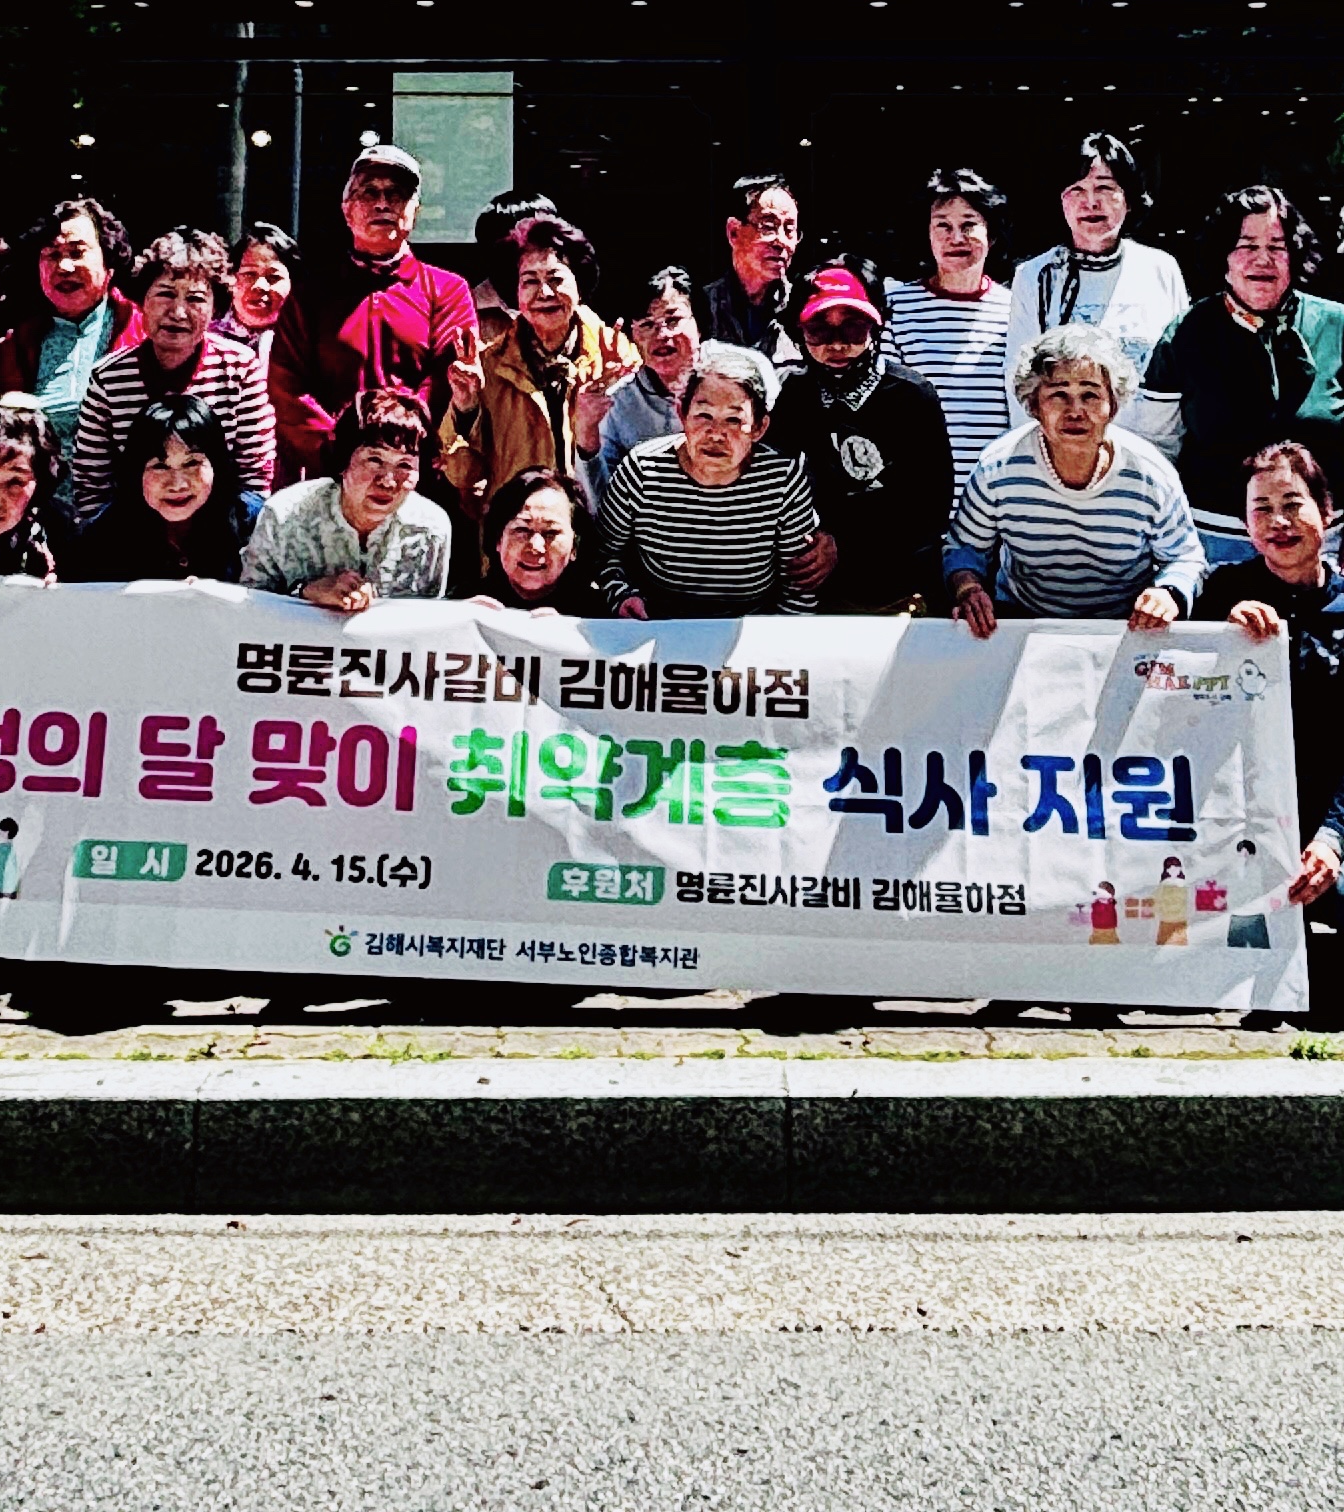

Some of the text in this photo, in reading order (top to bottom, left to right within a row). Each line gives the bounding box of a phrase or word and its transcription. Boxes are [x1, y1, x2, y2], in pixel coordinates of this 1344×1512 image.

[236, 642, 810, 719] 명륜진사갈비 김해율하점
[137, 712, 226, 803] 달
[247, 720, 419, 814] 맞이
[446, 726, 793, 830] 취약계층
[821, 746, 998, 838] 식사
[1022, 752, 1199, 844] 지원
[90, 844, 432, 890] 일 시 2026. 4. 15.(수)
[560, 867, 1027, 917] 후원처 명륜진사갈비 김해율하점
[364, 931, 699, 970] 김해시복지재단 서부노인종합복지관
